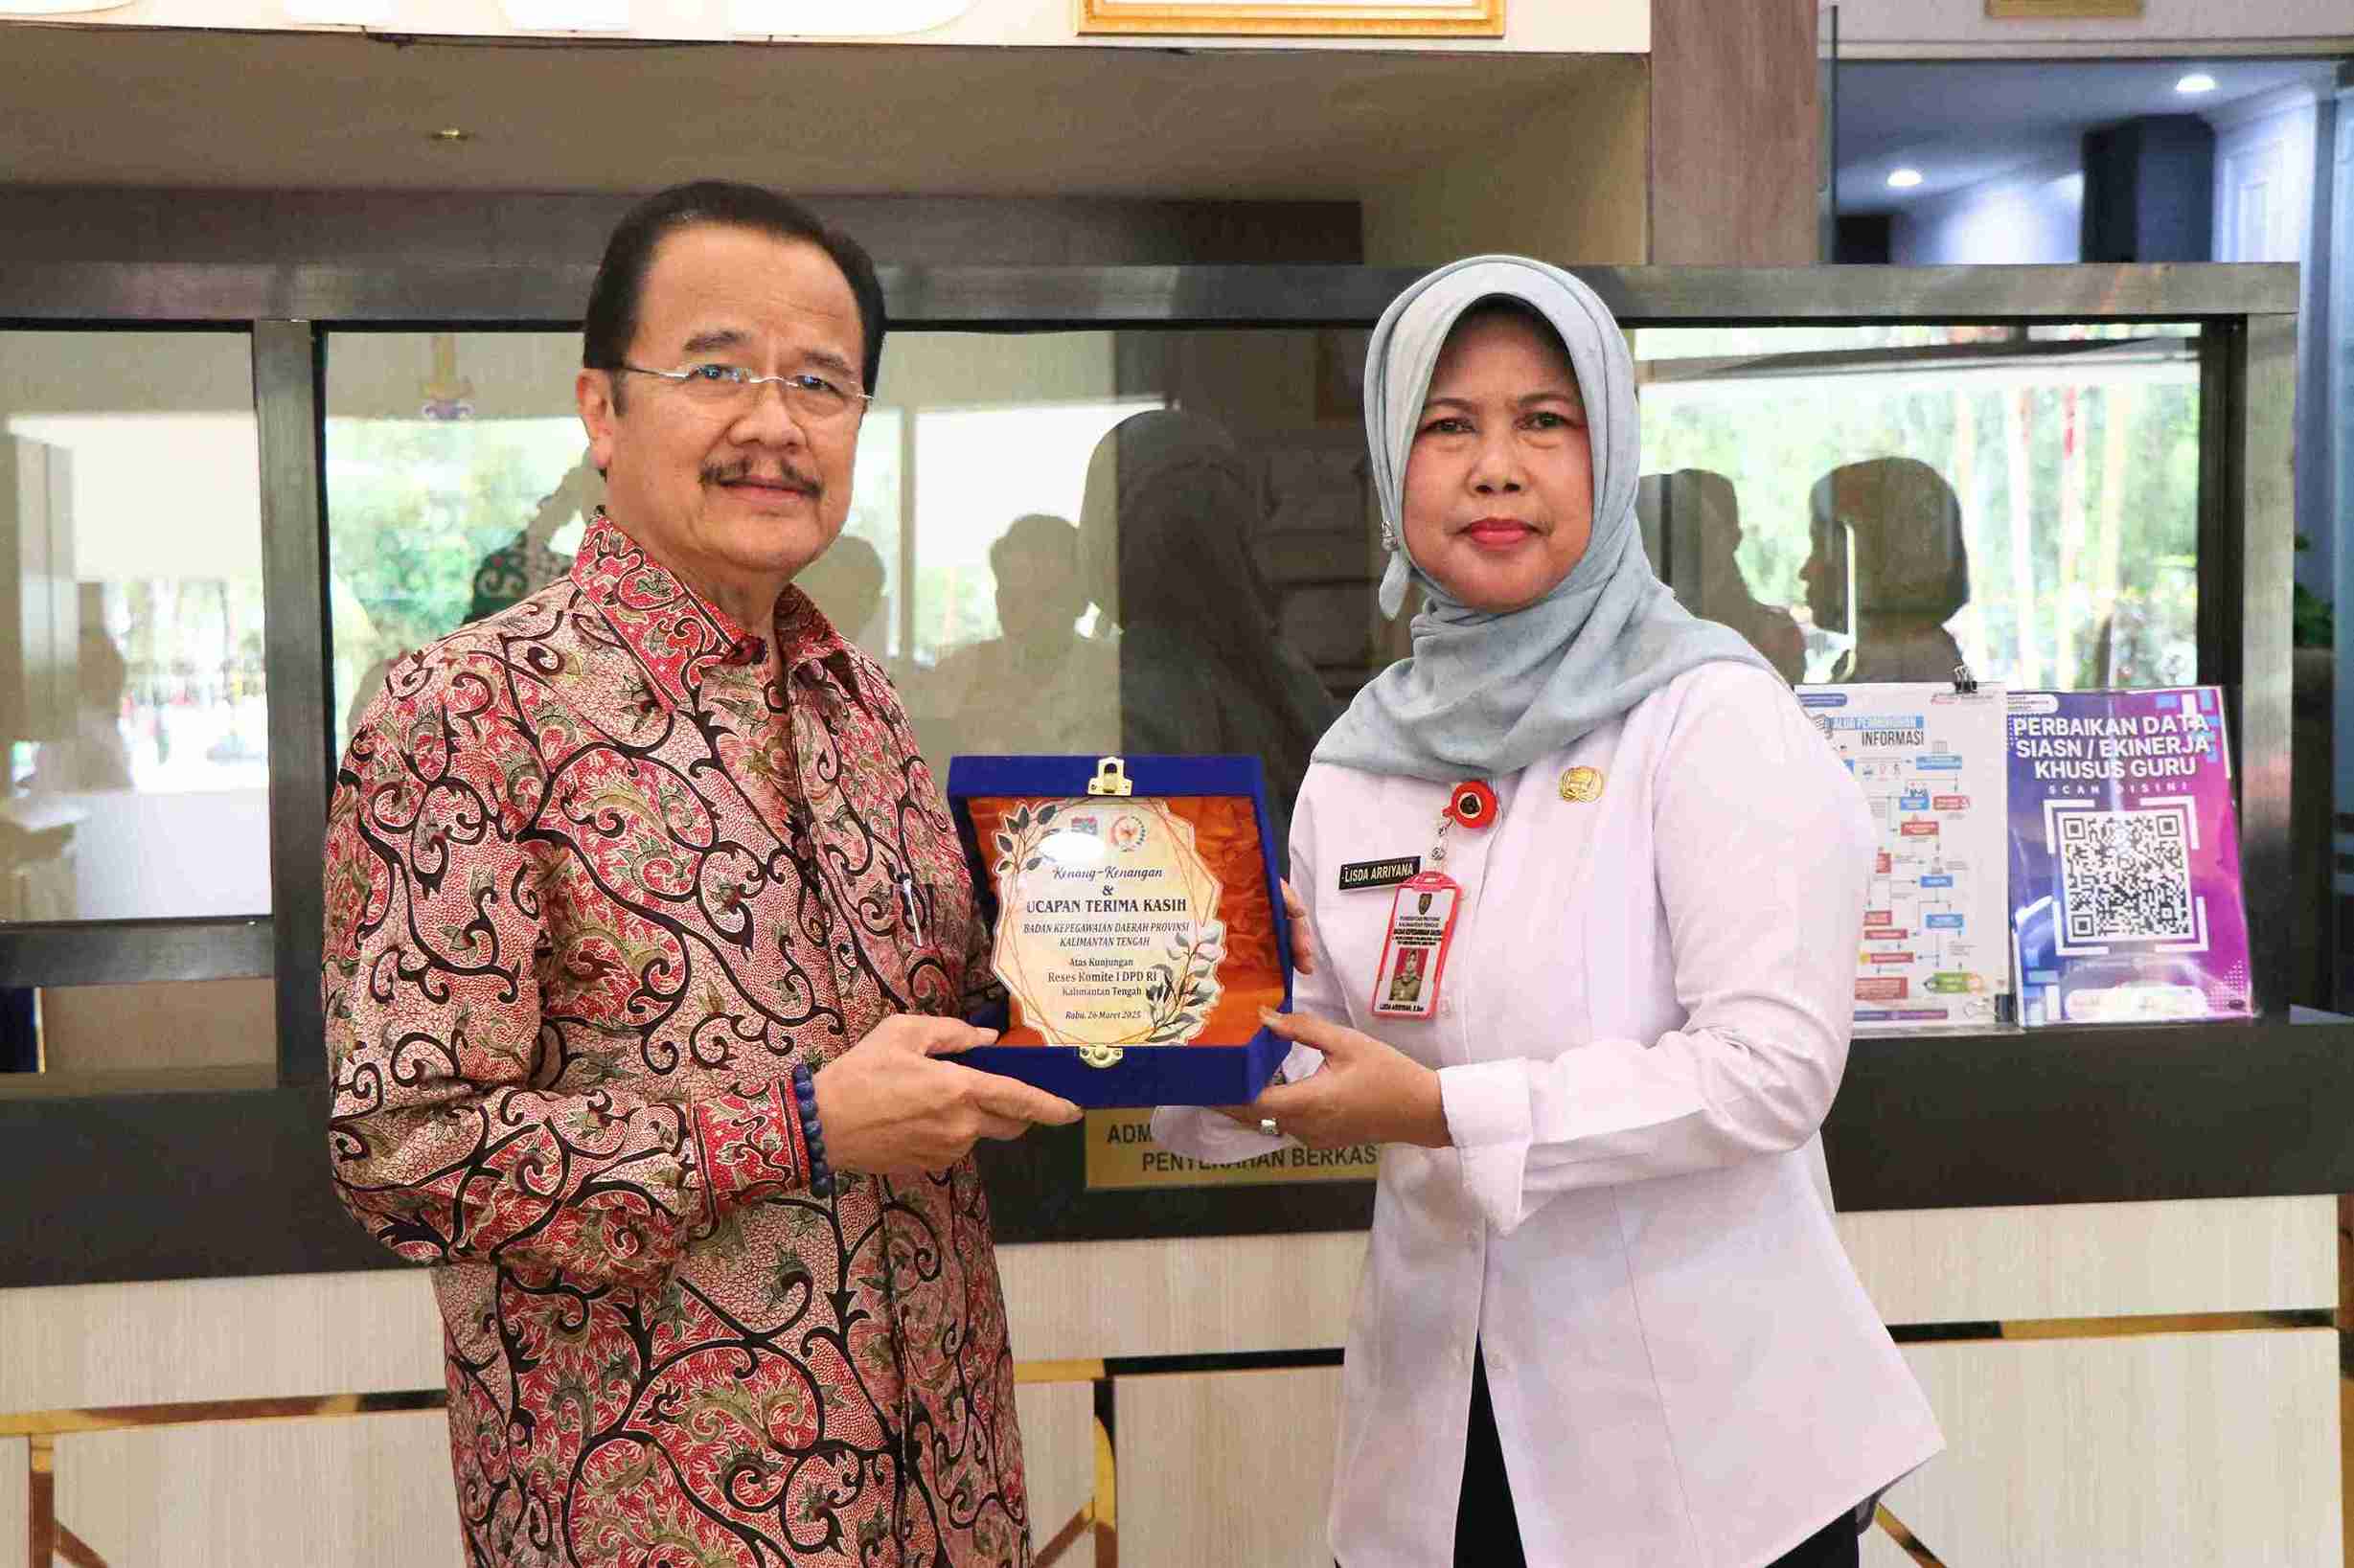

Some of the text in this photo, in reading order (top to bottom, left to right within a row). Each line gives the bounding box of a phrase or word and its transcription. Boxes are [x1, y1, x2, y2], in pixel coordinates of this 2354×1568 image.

[2013, 714, 2208, 737] PERBAIKAN DATA
[1861, 730, 1925, 746] INFORMASI
[2017, 736, 2209, 760] SIASN / EKINERJA
[2035, 757, 2197, 780] KHUSUS GURU
[1053, 866, 1163, 881] Kenang-Kenangan
[1344, 863, 1414, 882] LISDA ARRIYANA
[1102, 884, 1114, 897] &
[1027, 898, 1187, 913] UCAPAN TERIMA KASIH
[1023, 923, 1052, 934] BADAN
[1114, 922, 1149, 933] DAERAH
[1150, 921, 1190, 933] PROVINSI
[1060, 937, 1150, 947] KALIMANTAN TENGAH
[1048, 971, 1077, 982] Reses
[1078, 971, 1114, 982] Komite
[1121, 970, 1145, 982] DPD
[1146, 970, 1157, 982] RI
[1063, 987, 1142, 997] Kalimantan Tengah
[1291, 1144, 1377, 1167] BERKAS
